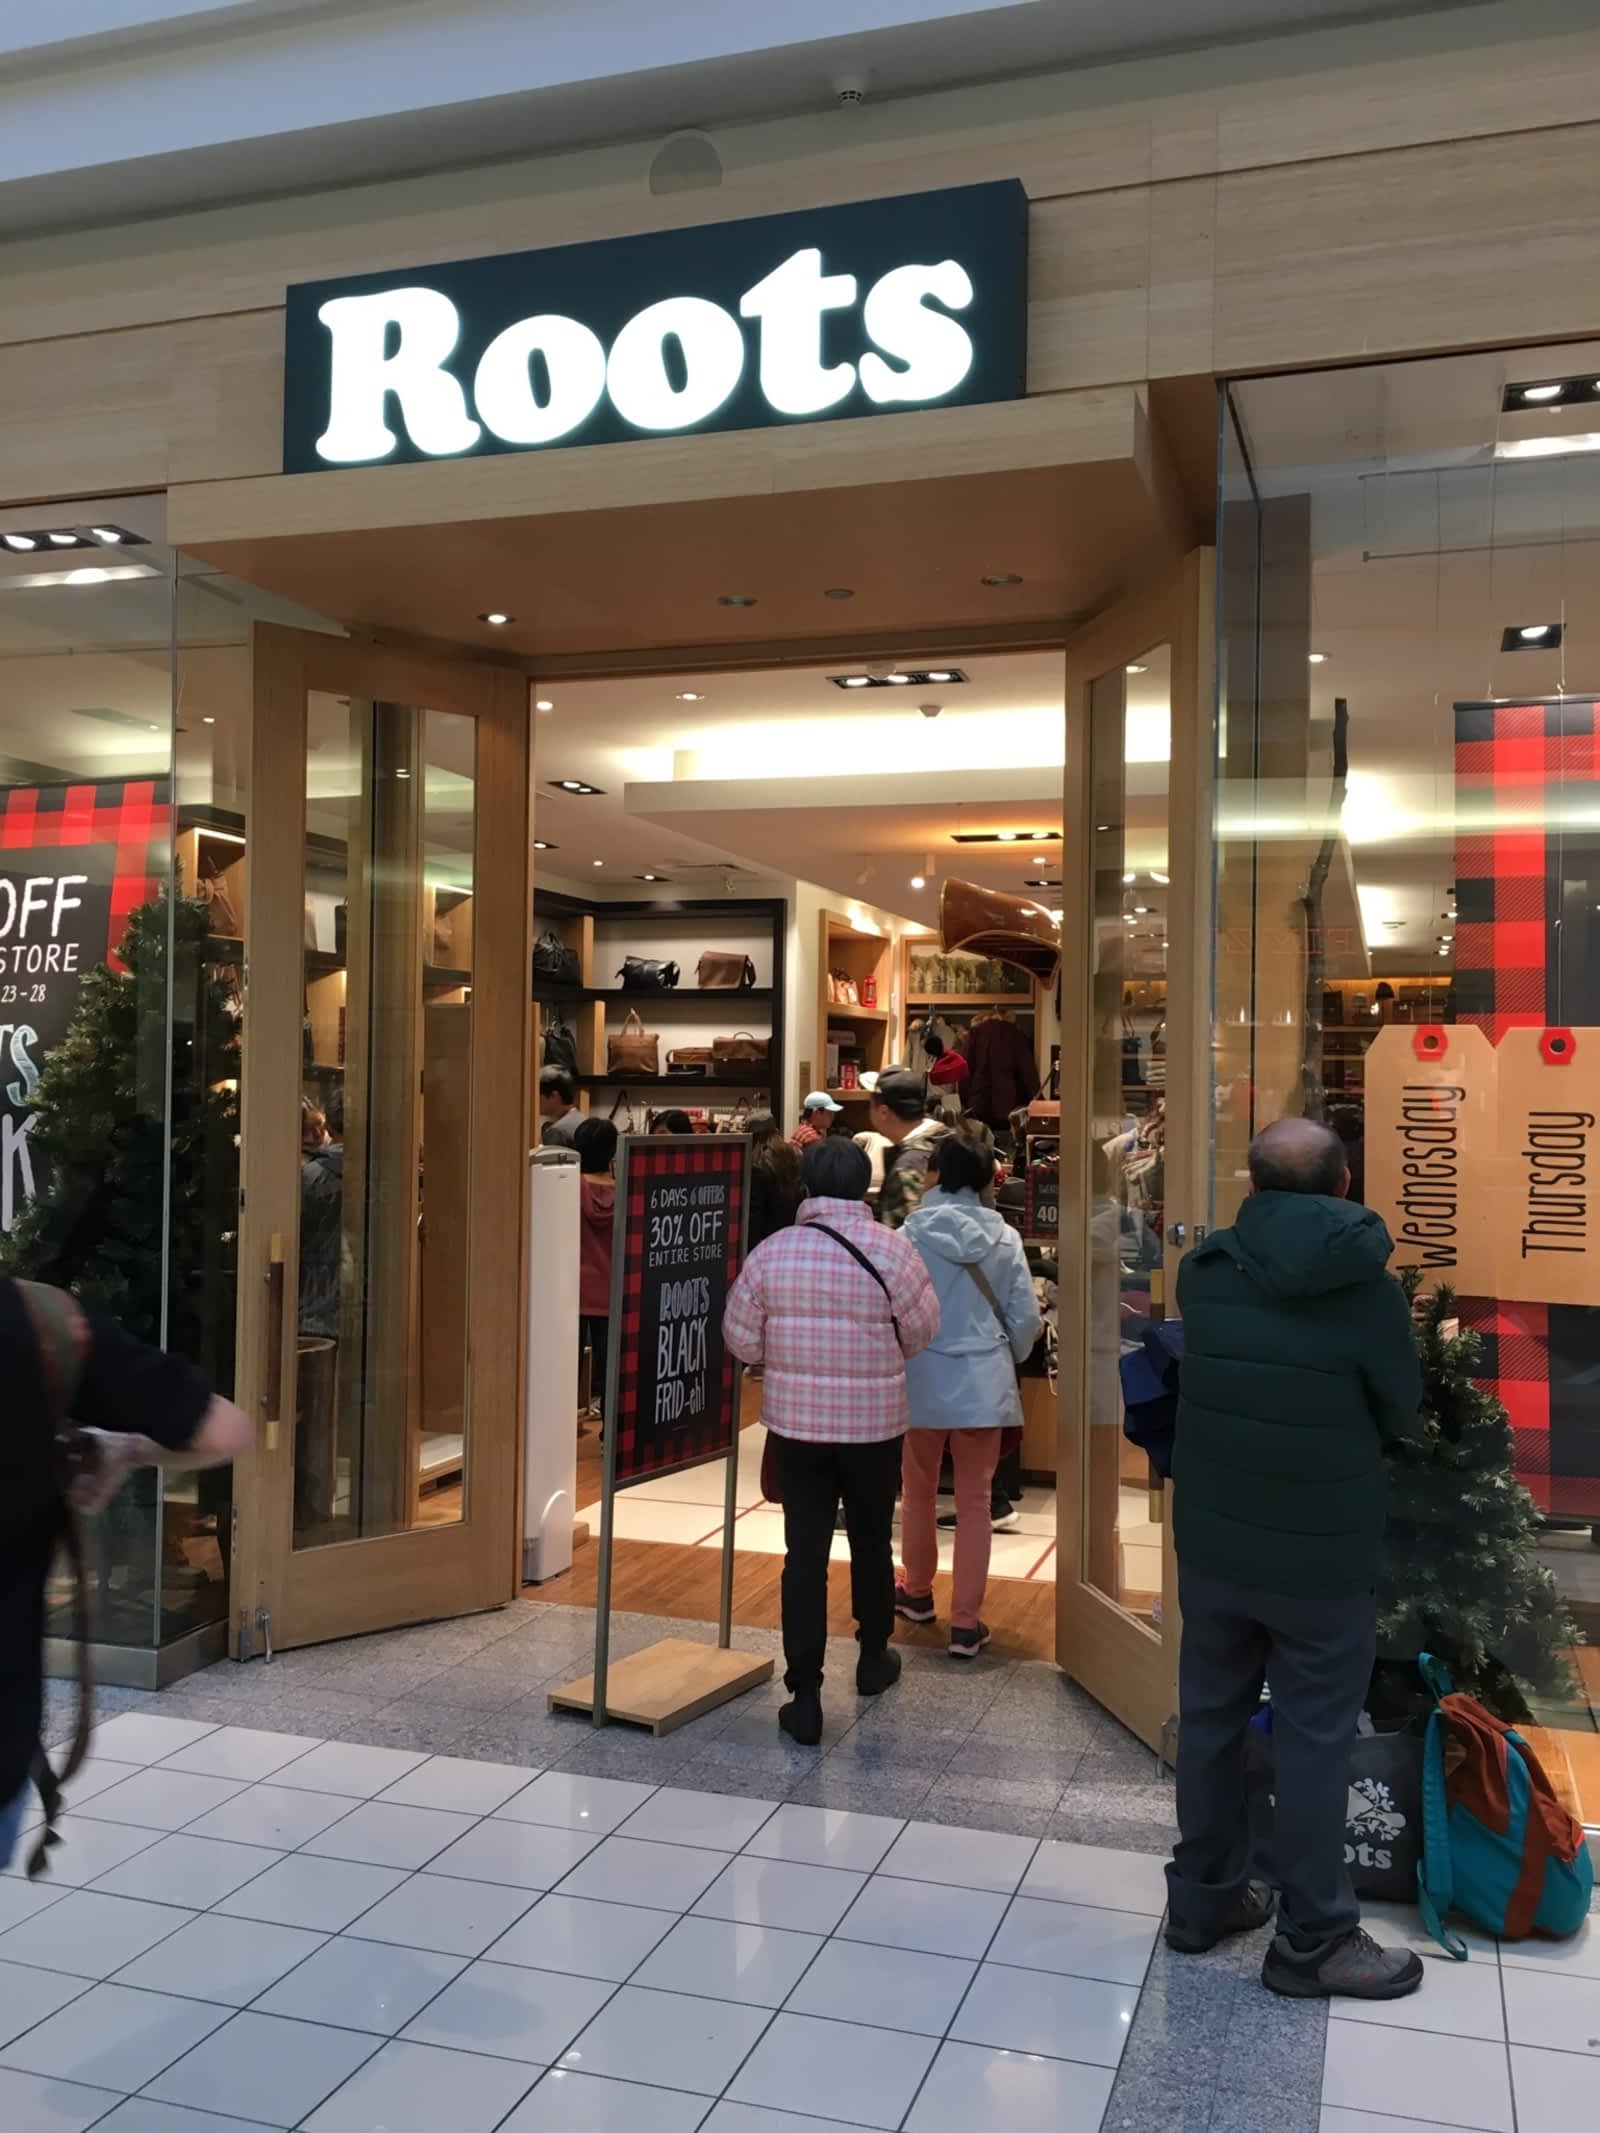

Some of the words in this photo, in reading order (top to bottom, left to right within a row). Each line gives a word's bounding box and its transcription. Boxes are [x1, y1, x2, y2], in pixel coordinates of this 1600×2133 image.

[316, 248, 973, 462] Roots
[650, 1190, 657, 1209] 6
[660, 1187, 688, 1208] DAYS
[1396, 1086, 1466, 1270] Wednesday
[1522, 1112, 1595, 1259] Thursday
[649, 1247, 689, 1267] ENTIRE
[693, 1243, 722, 1261] STORE
[650, 1213, 684, 1248] 30%
[689, 1210, 723, 1243] OFF
[659, 1276, 710, 1322] ROOTS
[657, 1315, 708, 1380] BLACK
